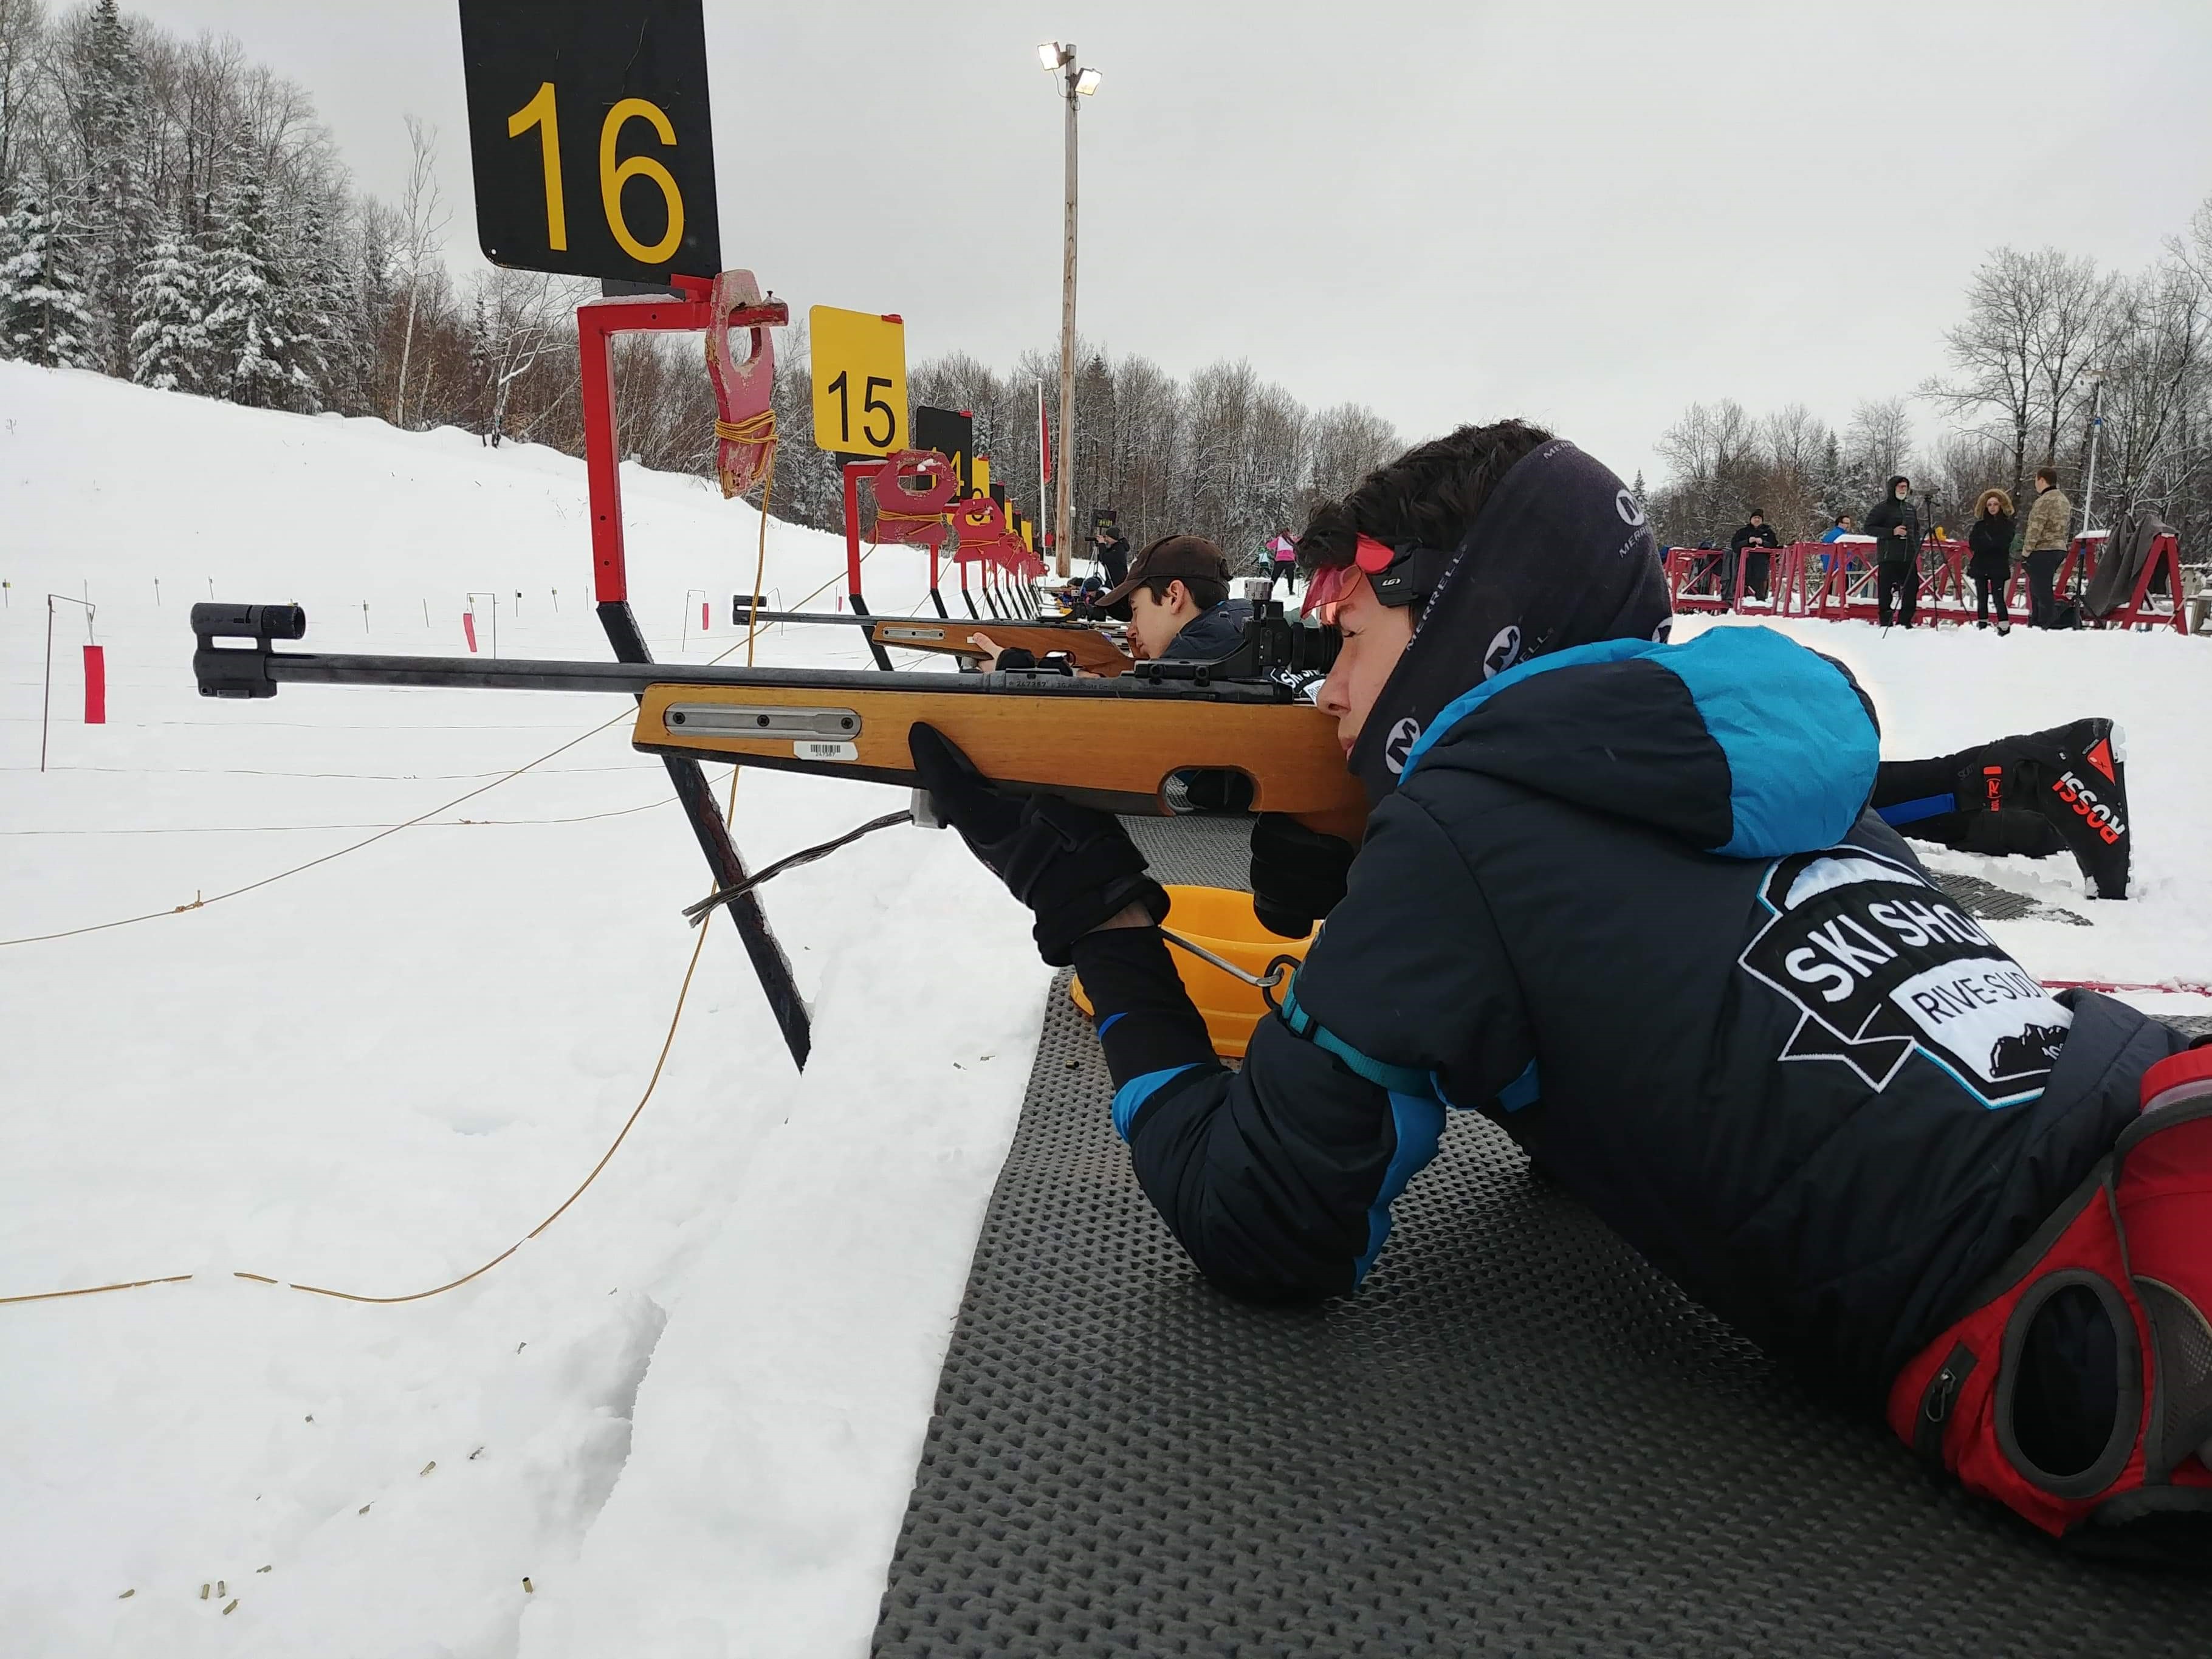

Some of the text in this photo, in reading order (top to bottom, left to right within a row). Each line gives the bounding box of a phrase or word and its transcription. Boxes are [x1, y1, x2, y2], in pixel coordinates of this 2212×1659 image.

[508, 81, 684, 264] 16
[828, 370, 896, 448] 15
[2052, 771, 2125, 844] ROSSI
[1785, 913, 1899, 1003] SKI
[1910, 971, 2042, 1025] RIVE-SUD
